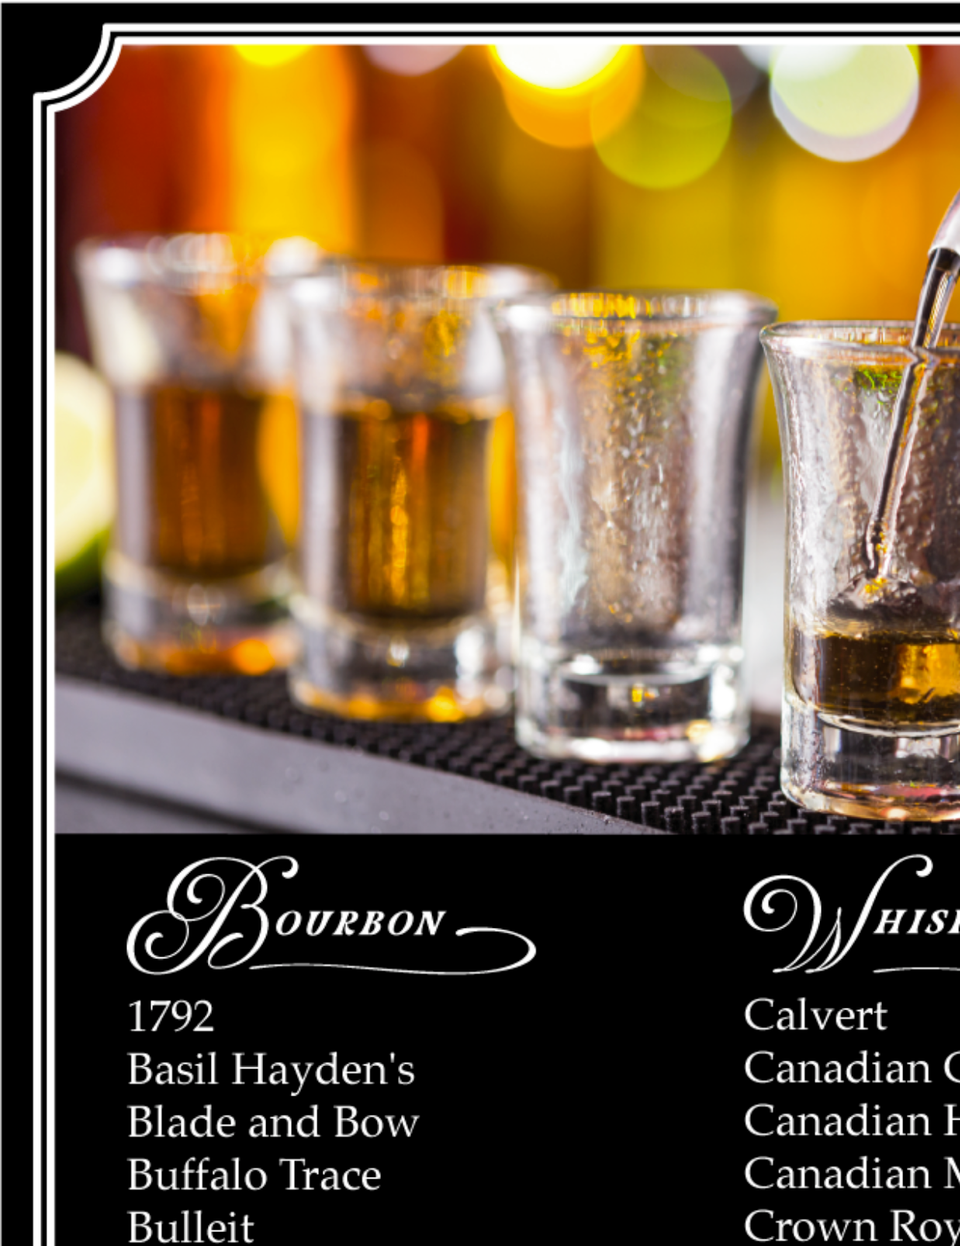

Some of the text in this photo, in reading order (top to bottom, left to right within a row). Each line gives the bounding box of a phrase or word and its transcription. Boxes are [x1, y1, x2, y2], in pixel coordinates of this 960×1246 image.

[126, 855, 446, 976] BOURBON
[128, 999, 215, 1032] 1792
[744, 996, 889, 1031] Calvert
[126, 1051, 415, 1097] Basil Hayden's
[744, 1049, 933, 1084] Canadian
[126, 1103, 420, 1138] Blade and Bow
[744, 1102, 933, 1137] Canadian
[126, 1156, 382, 1191] Buffalo Trace
[744, 1155, 933, 1190] Canadian
[126, 1209, 255, 1244] Bulleit
[744, 1208, 879, 1243] Crown
